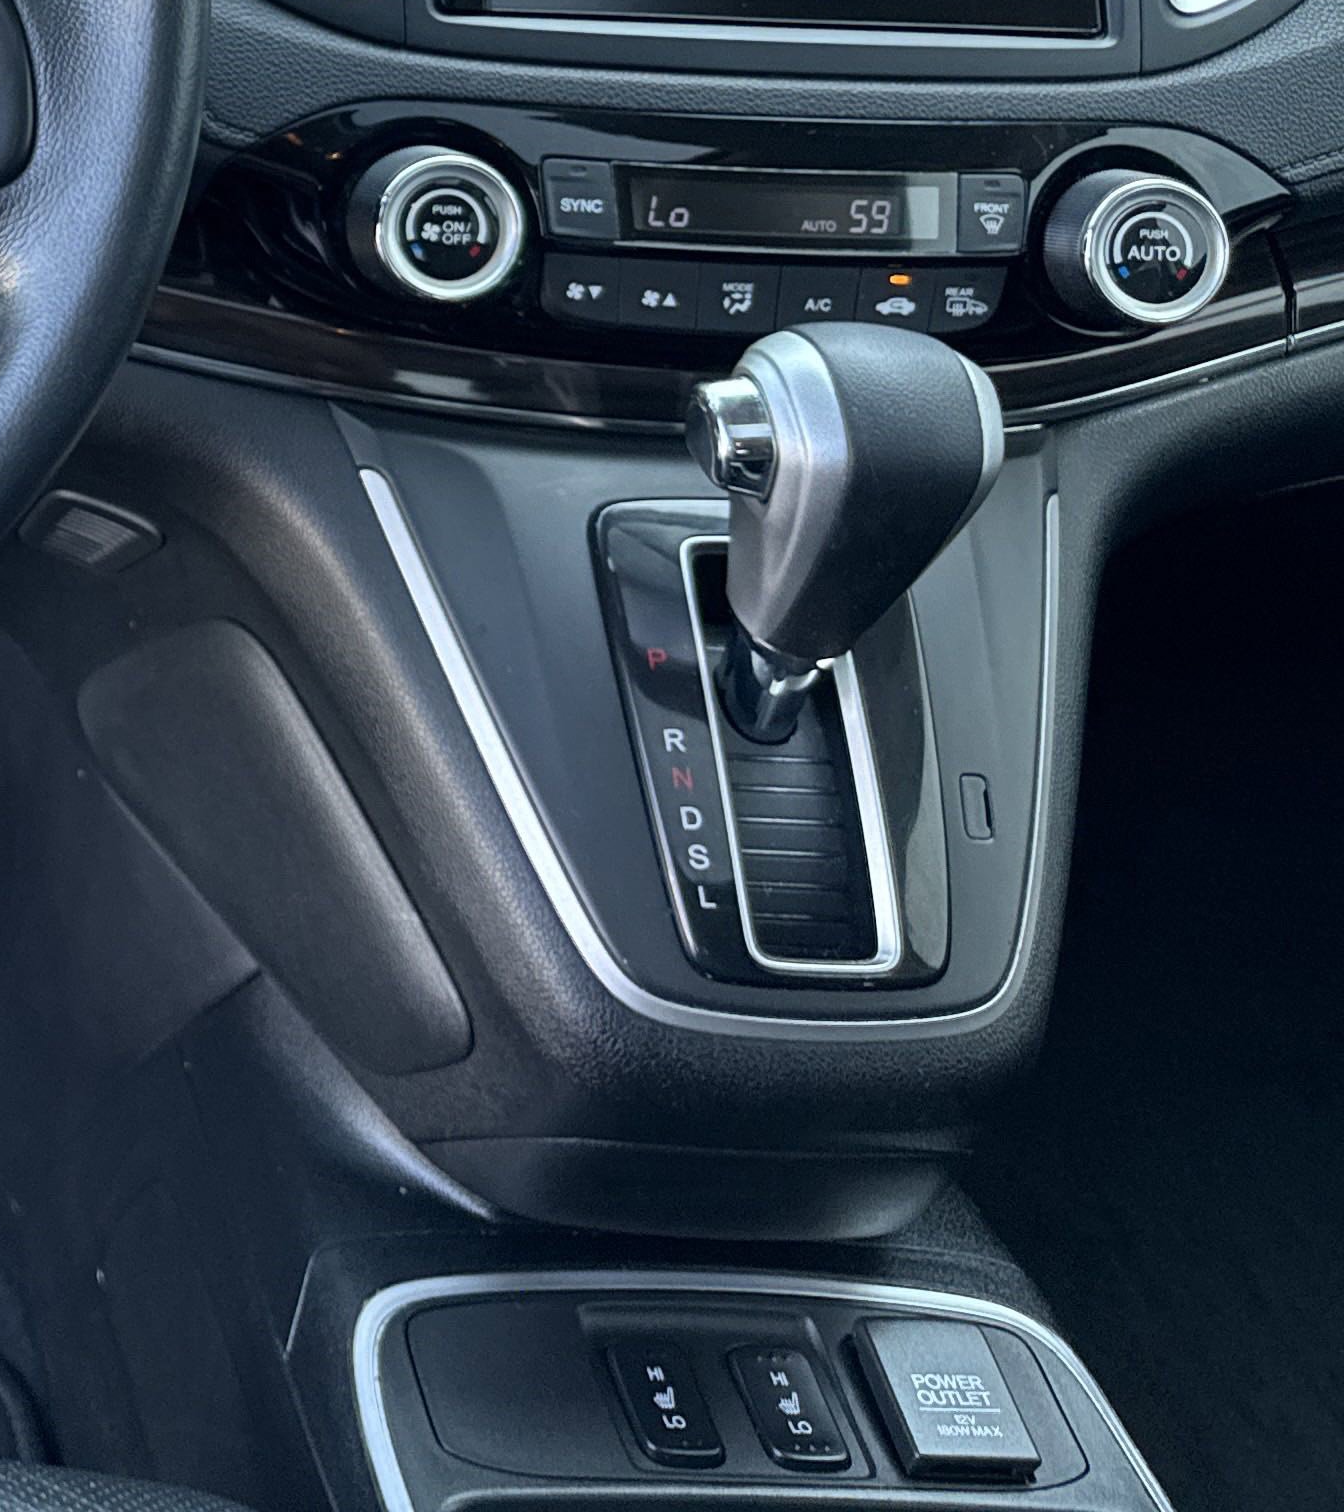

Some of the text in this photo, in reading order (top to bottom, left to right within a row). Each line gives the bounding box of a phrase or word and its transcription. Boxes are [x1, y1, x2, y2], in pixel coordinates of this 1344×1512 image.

[432, 205, 462, 215] PUSH
[560, 198, 604, 214] SYNC
[974, 203, 1009, 214] FRONT
[801, 220, 837, 233] AUTO
[1140, 229, 1168, 239] PUSH
[442, 234, 471, 245] OFF
[1127, 246, 1181, 261] AUTO
[945, 288, 974, 297] REAR
[804, 298, 831, 312] A/C
[646, 648, 667, 671] P
[663, 728, 686, 753] R
[672, 767, 693, 791] N
[680, 806, 701, 831] D
[688, 845, 710, 870] S
[697, 885, 717, 909] L
[646, 1366, 665, 1381] HI
[770, 1371, 790, 1386] HI
[911, 1373, 985, 1390] POWER
[916, 1389, 992, 1406] OUTLET
[953, 1414, 976, 1425] 12V
